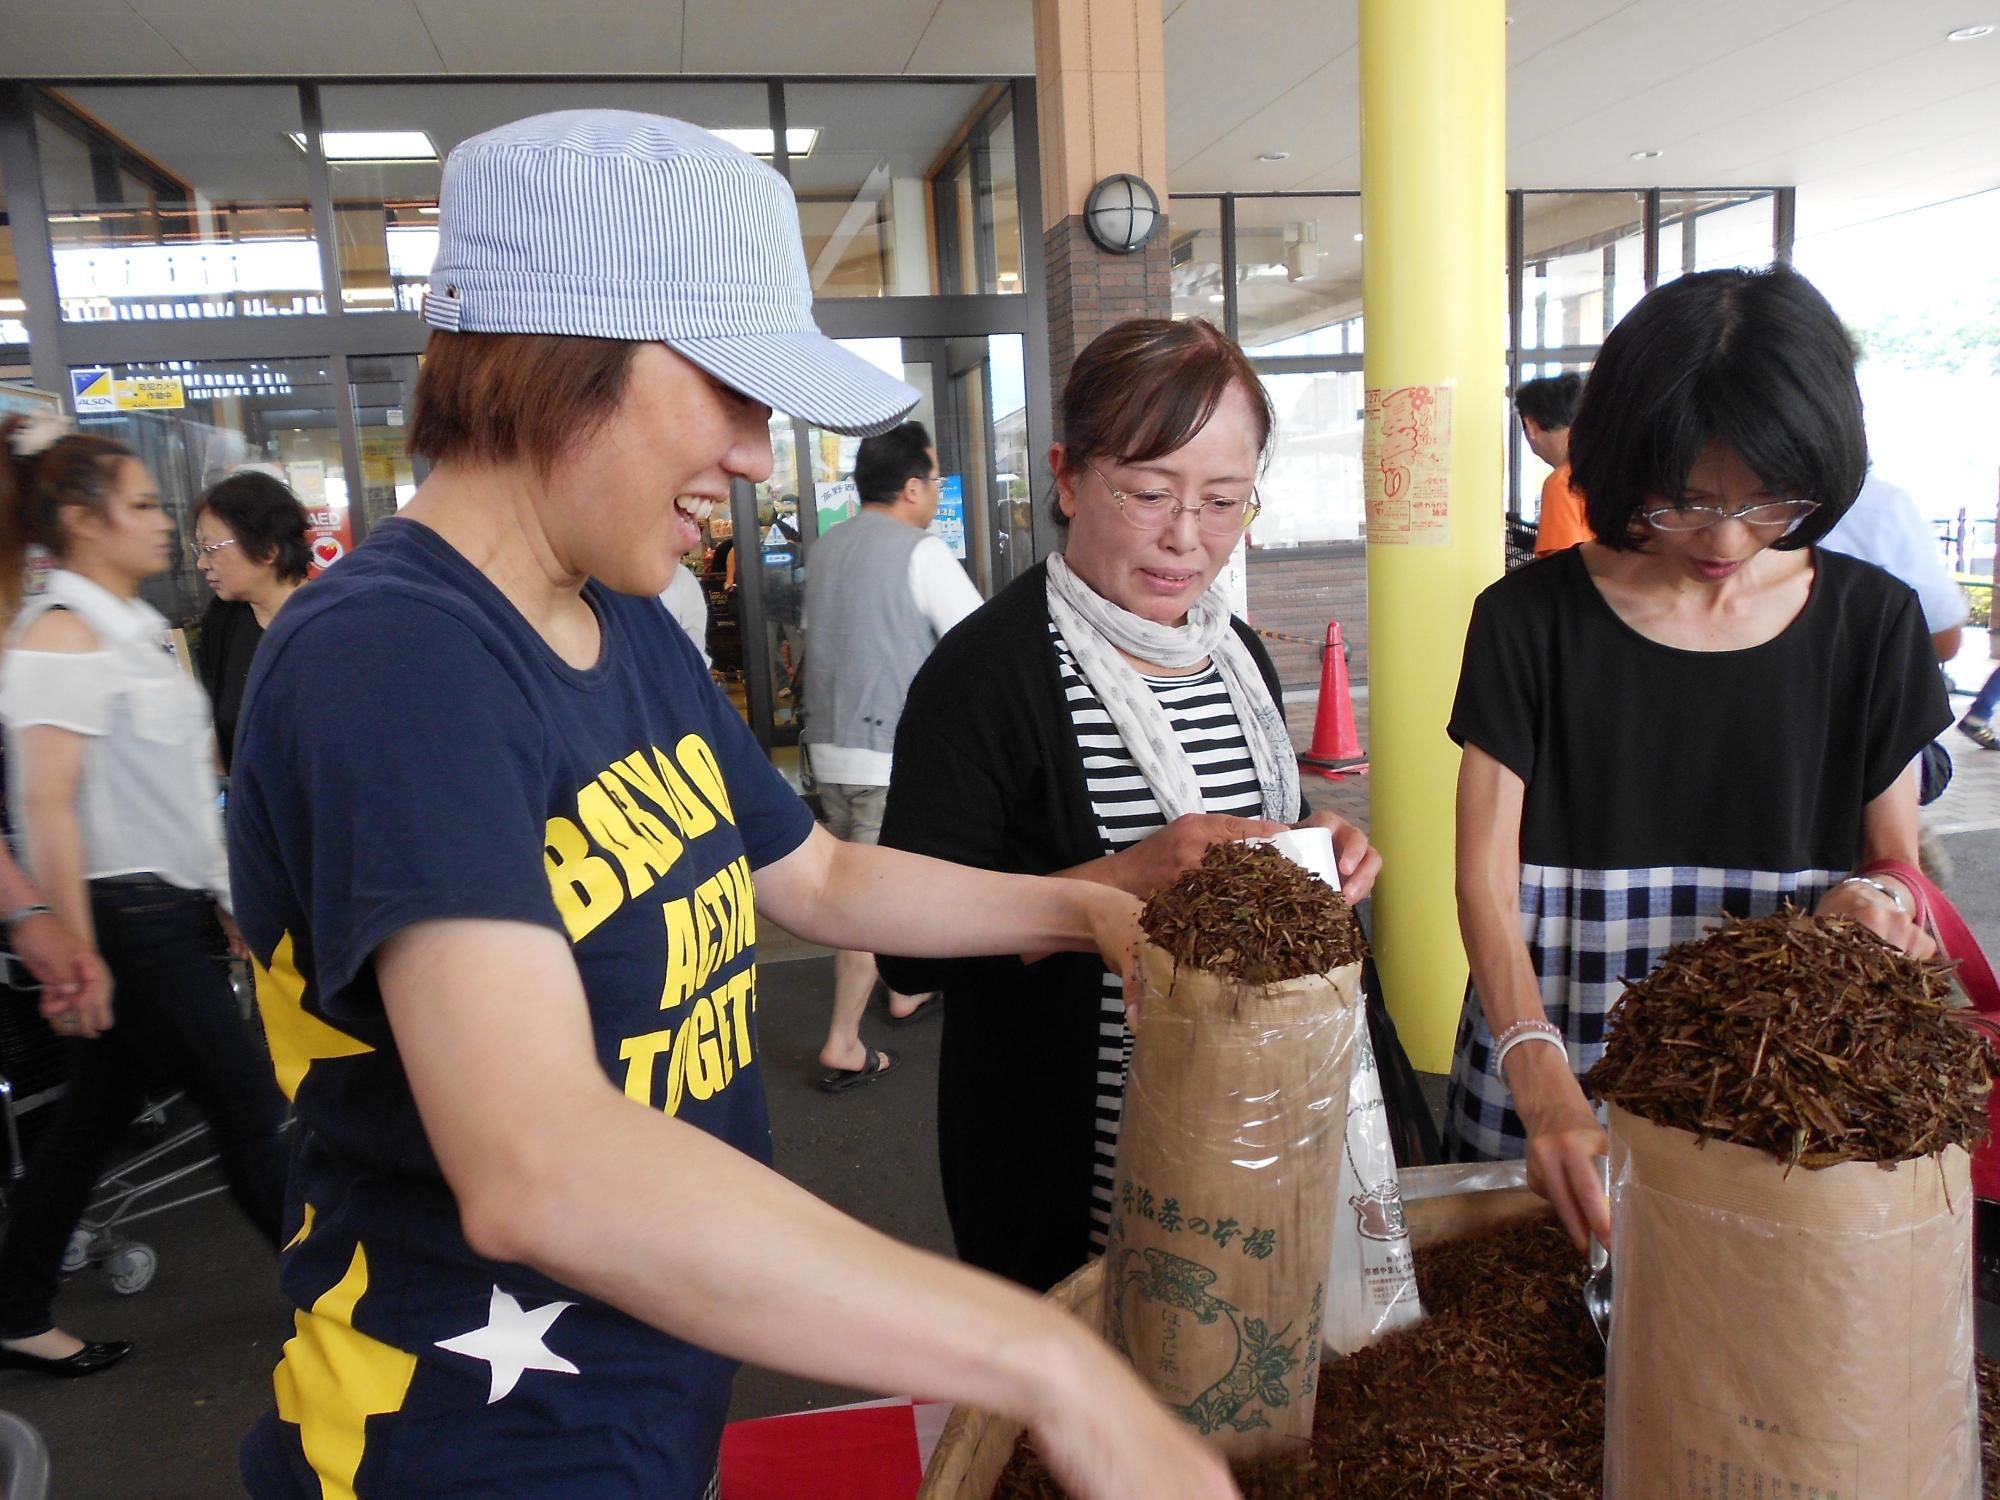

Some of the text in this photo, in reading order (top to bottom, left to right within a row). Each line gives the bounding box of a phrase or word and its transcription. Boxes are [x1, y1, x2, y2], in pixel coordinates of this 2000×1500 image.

[307, 513, 341, 525] AED
[1159, 1308, 1182, 1374] ほうじ茶
